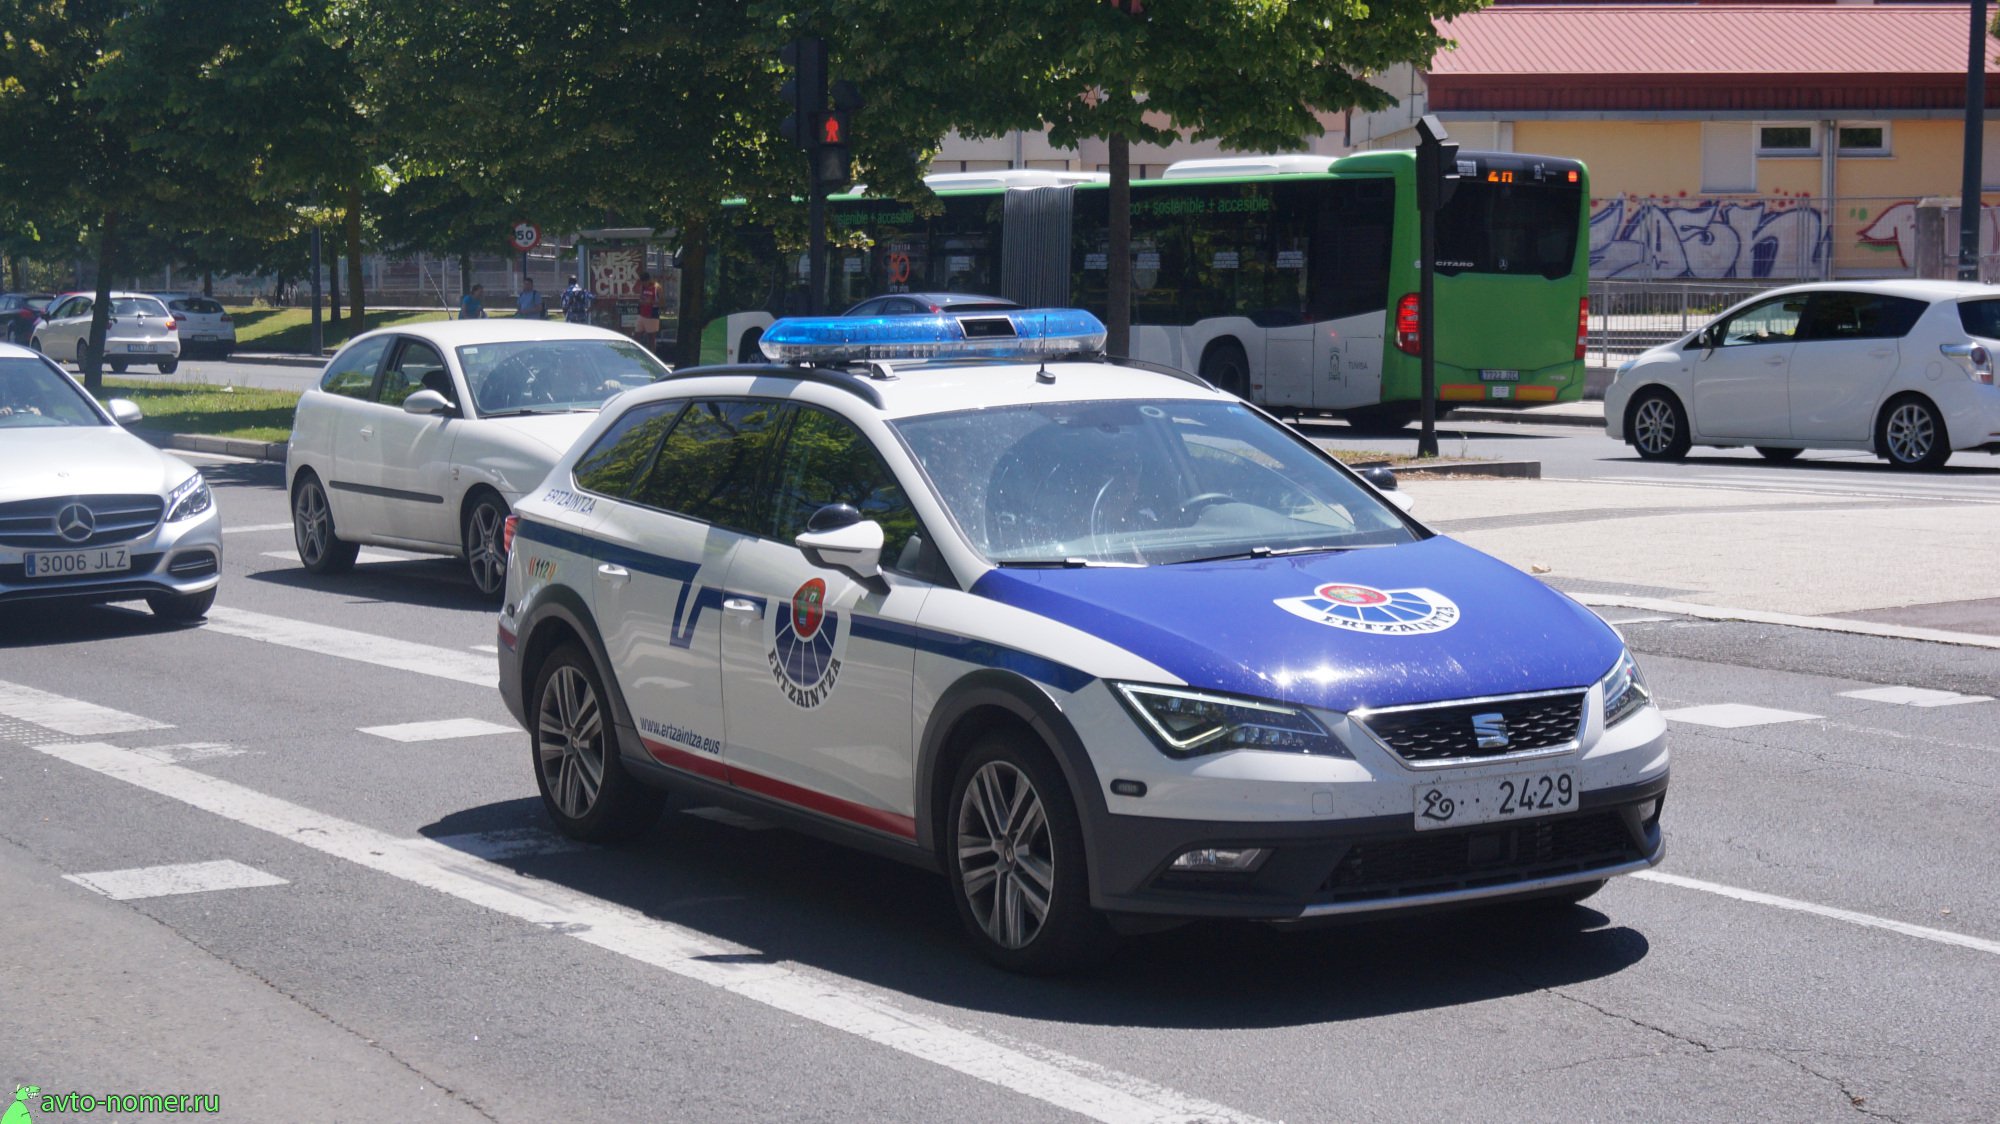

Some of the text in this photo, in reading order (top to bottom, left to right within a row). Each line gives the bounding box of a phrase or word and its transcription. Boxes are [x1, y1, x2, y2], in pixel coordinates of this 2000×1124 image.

[1153, 195, 1204, 216] sostenible
[1217, 194, 1269, 213] accesible
[516, 230, 534, 241] 50
[591, 263, 640, 282] YORK
[595, 280, 637, 297] CITY
[542, 488, 597, 514] ERTZAINTZA
[39, 550, 127, 573] 3006 JLZ
[1322, 606, 1455, 632] ERTZAINTZA
[767, 648, 842, 709] ERTZAINTZA
[640, 716, 720, 755] www.ertzaintza.eus
[1499, 773, 1573, 815] 2429
